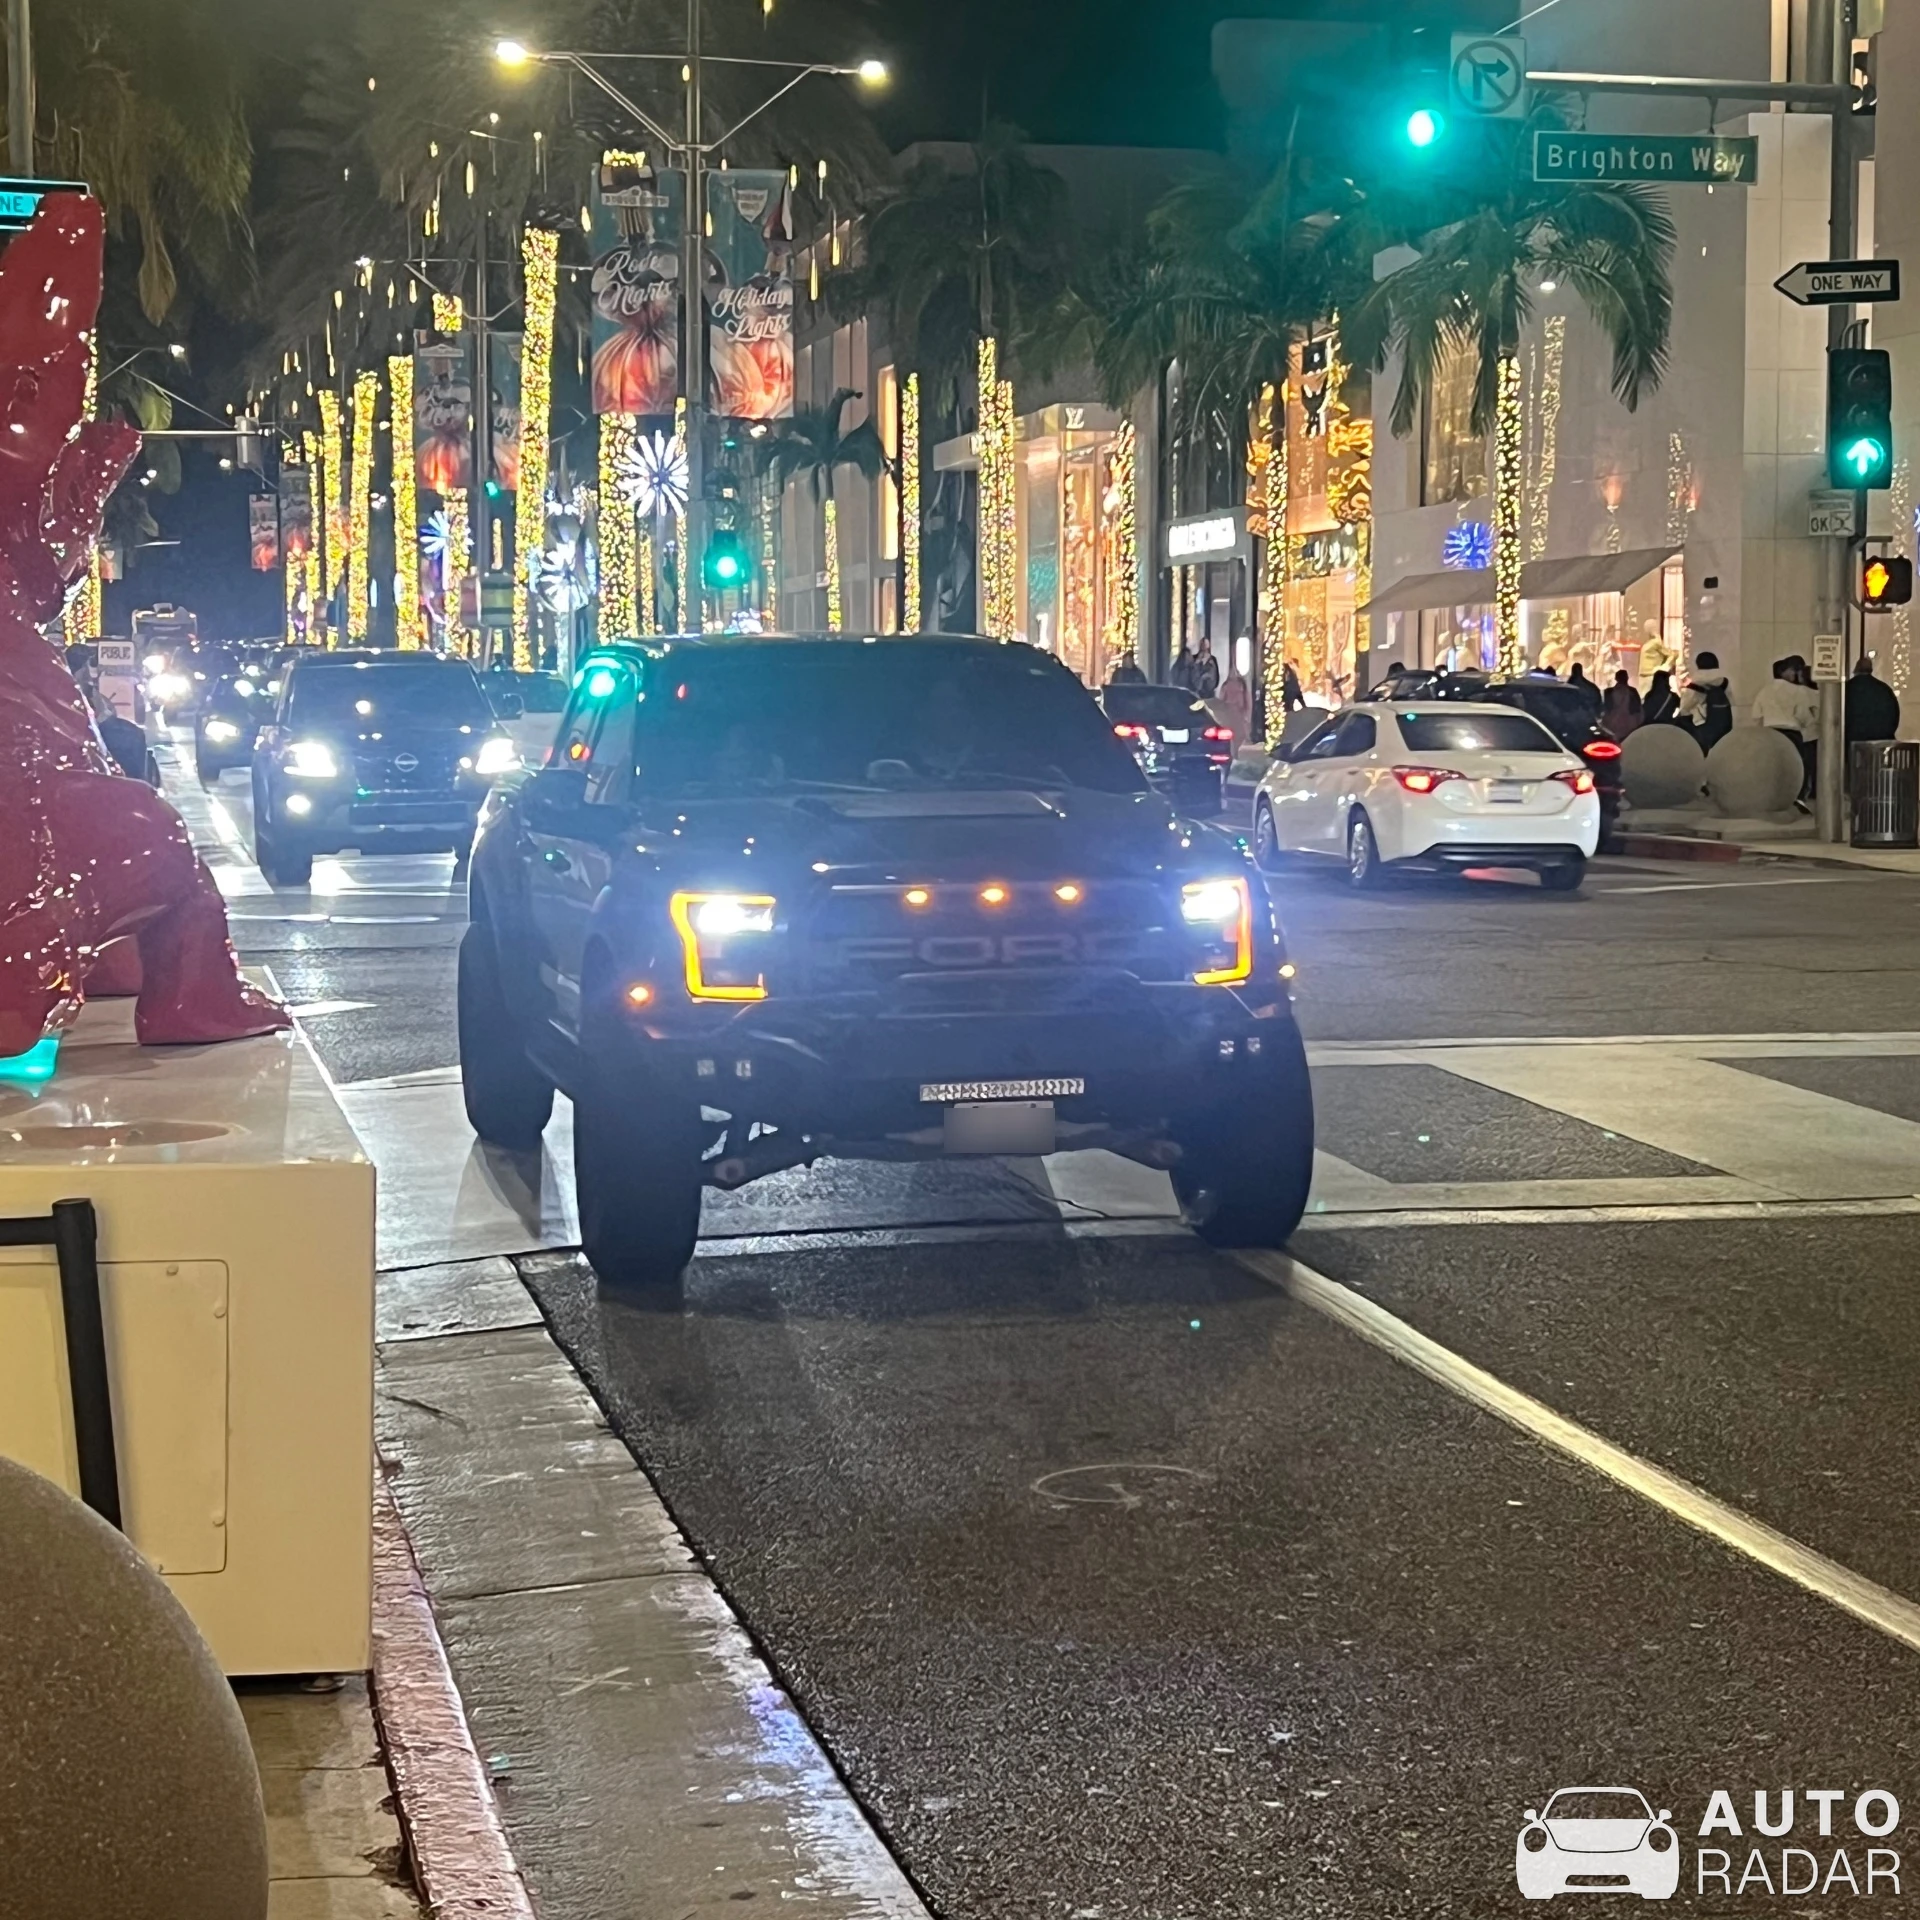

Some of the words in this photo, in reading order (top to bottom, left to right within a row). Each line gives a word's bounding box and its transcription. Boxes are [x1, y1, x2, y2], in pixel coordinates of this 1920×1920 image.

[1547, 144, 1673, 177] Brighton
[1691, 147, 1745, 178] Way
[0, 196, 24, 213] NE
[1811, 274, 1843, 291] ONE
[1850, 273, 1883, 289] WAY
[711, 286, 788, 319] Holiday
[724, 314, 792, 342] Lights
[1810, 517, 1829, 532] OK
